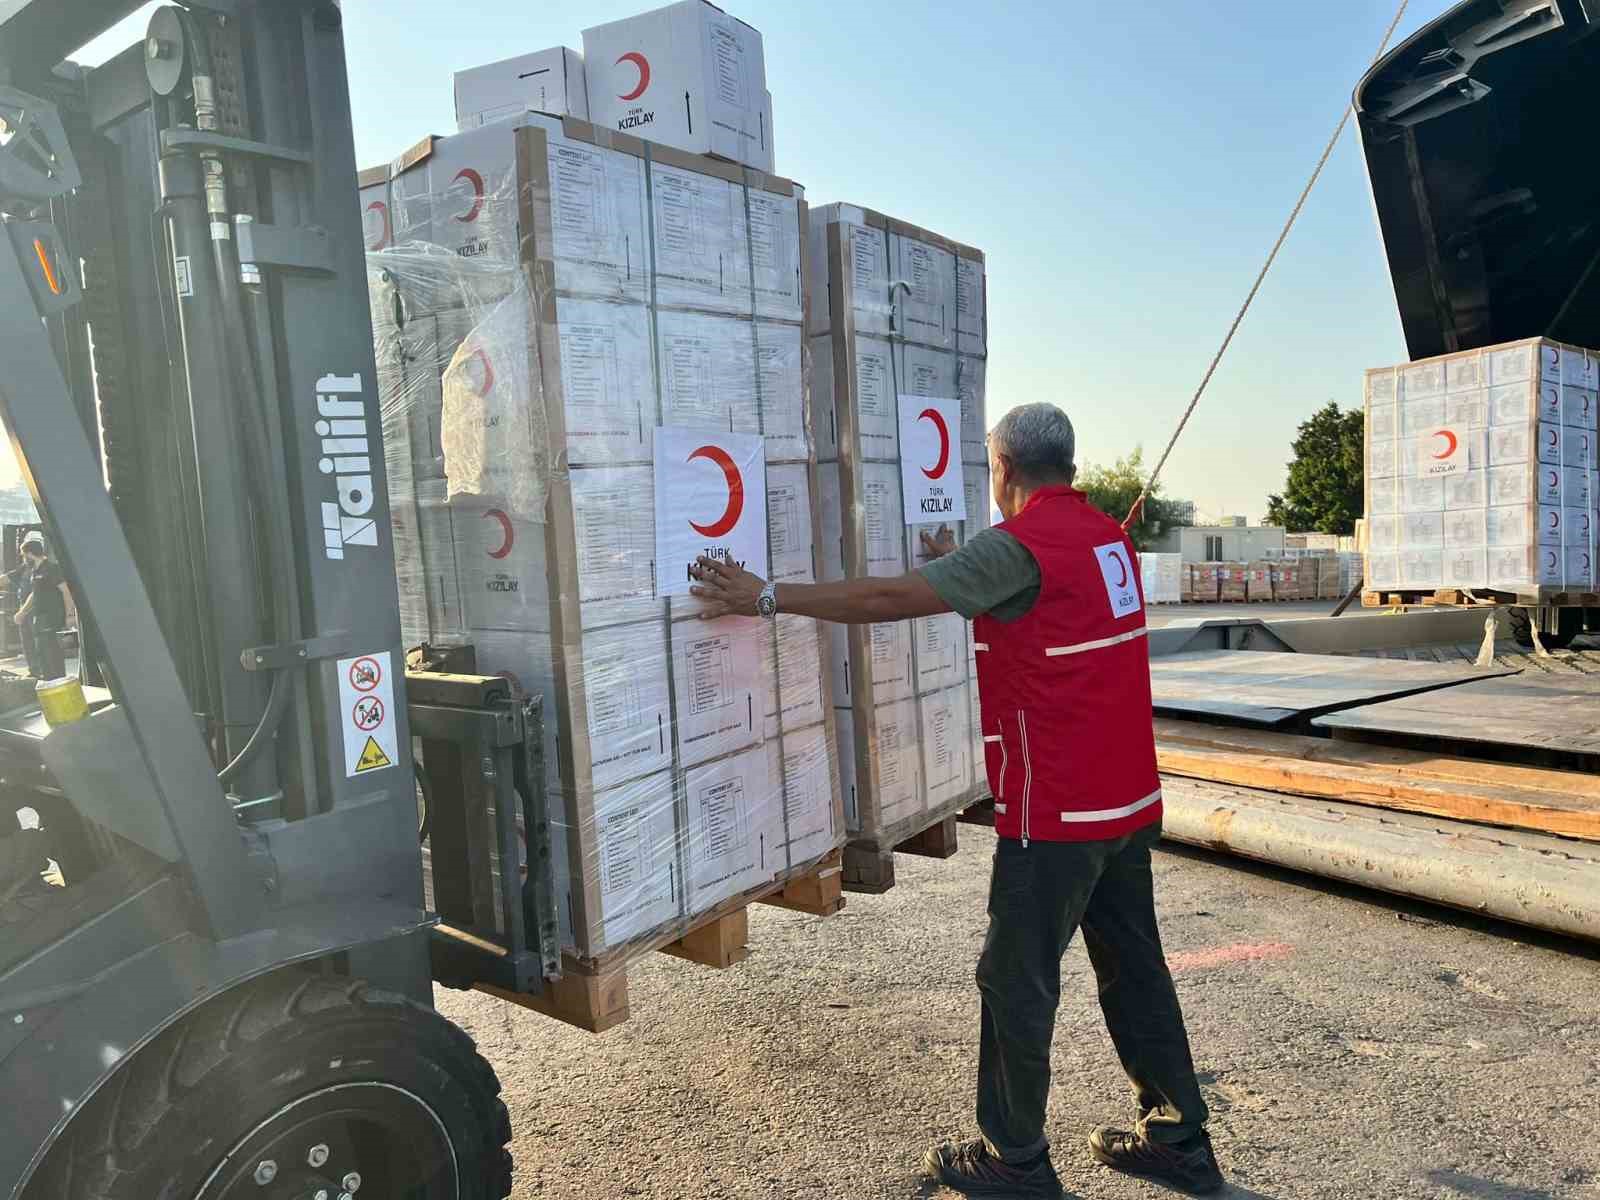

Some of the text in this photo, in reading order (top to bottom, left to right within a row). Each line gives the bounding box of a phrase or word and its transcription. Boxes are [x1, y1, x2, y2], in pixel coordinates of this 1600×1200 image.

[618, 111, 655, 130] KIZILAY
[920, 498, 953, 513] KIZILAY
[703, 545, 730, 560] TÜRK
